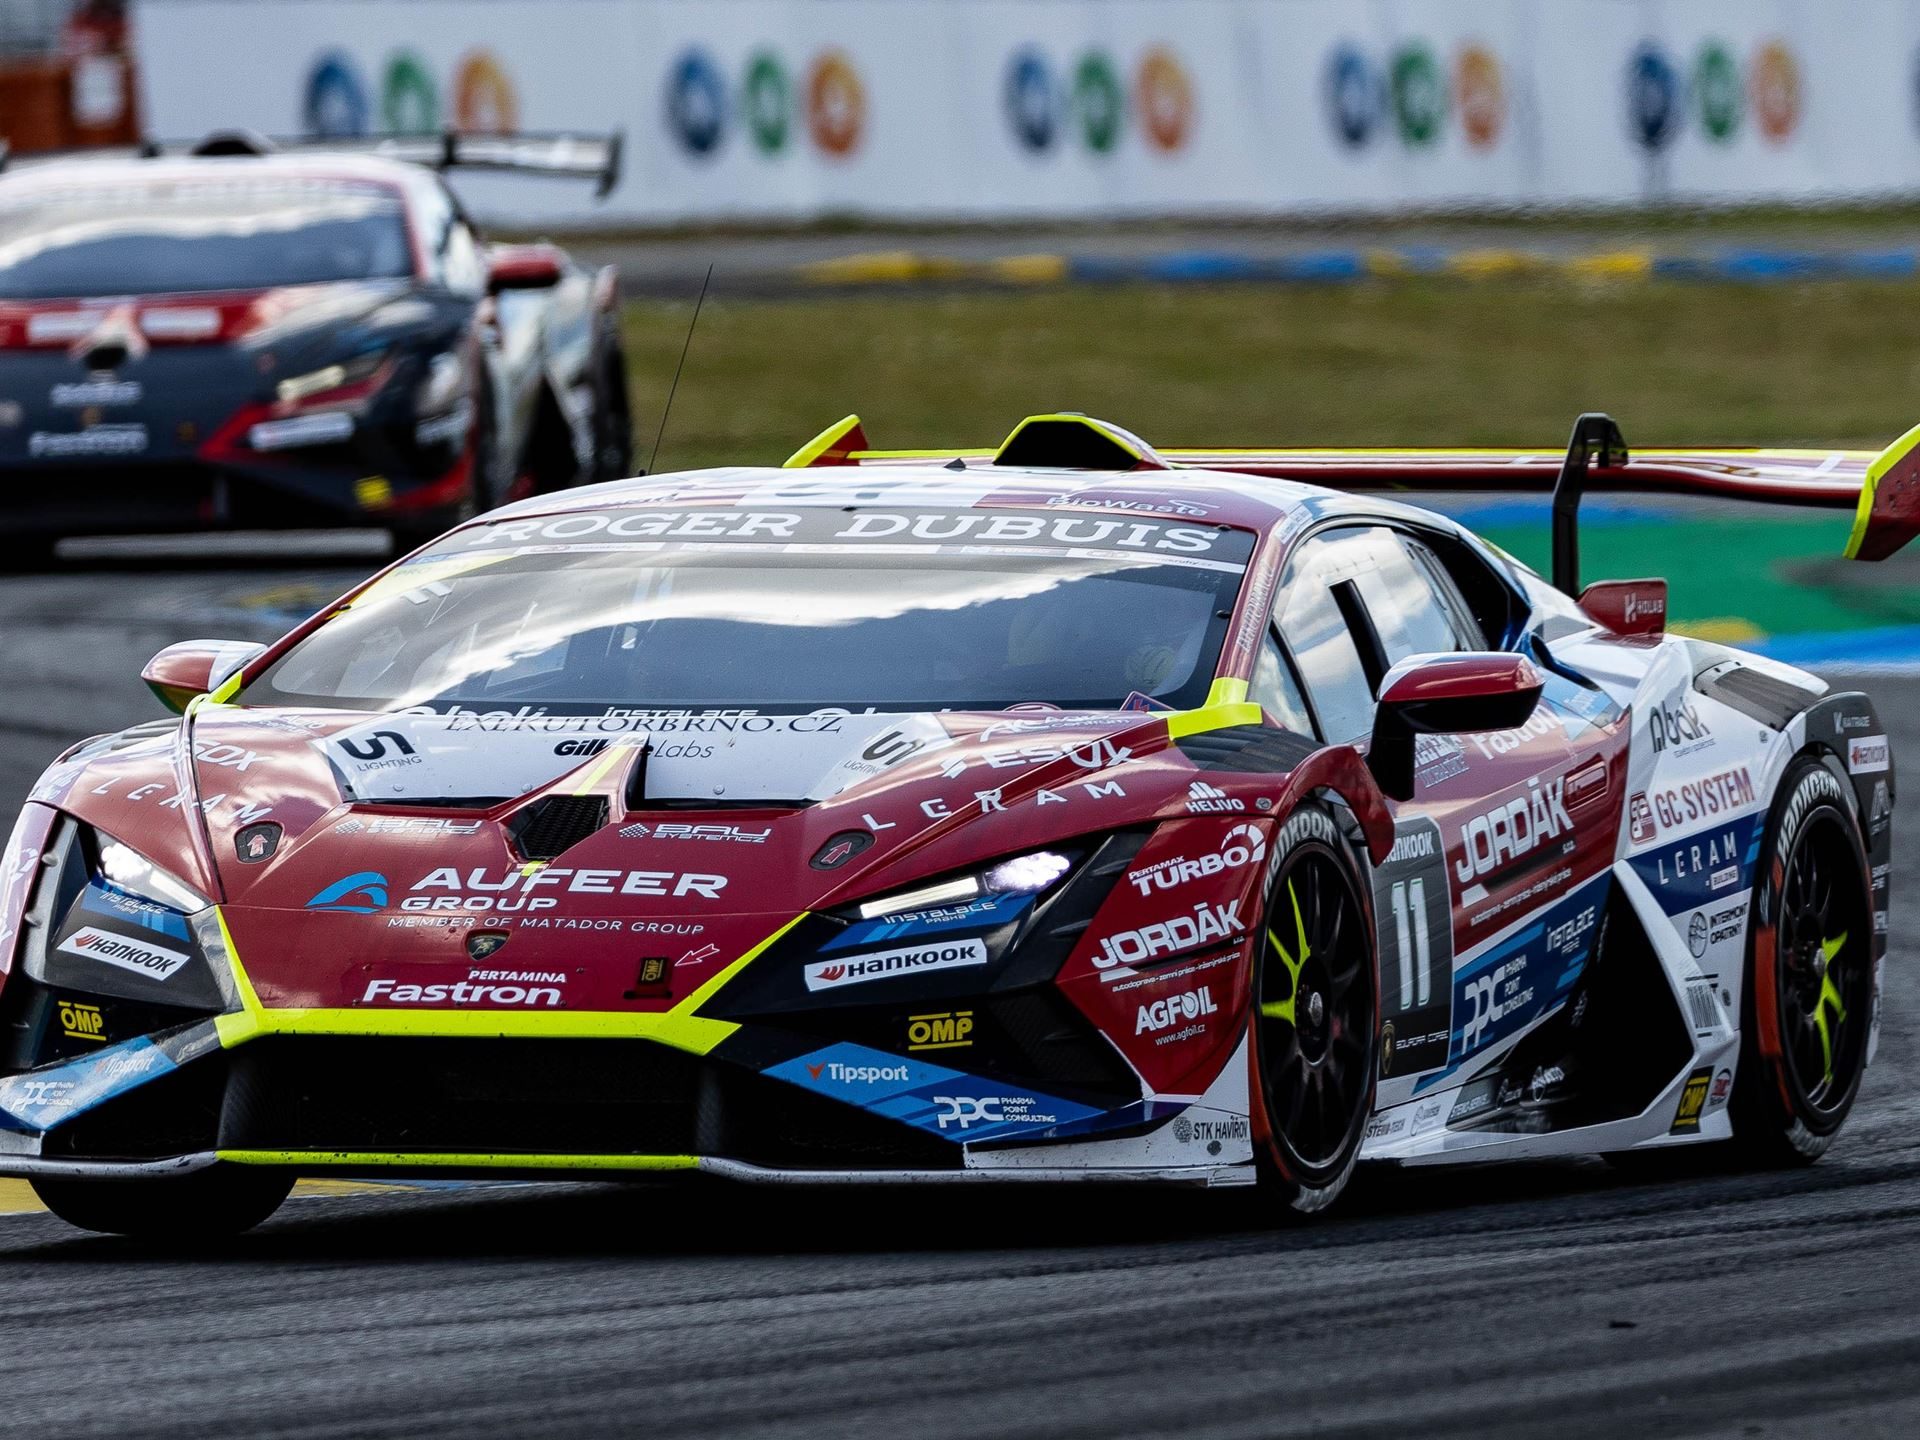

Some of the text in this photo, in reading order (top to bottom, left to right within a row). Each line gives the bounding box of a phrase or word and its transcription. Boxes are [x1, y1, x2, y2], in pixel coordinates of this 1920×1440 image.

[469, 512, 1221, 553] ROGER DUBUIS
[653, 740, 714, 758] Labs
[355, 754, 423, 773] LIGHTING
[862, 780, 1126, 831] LERAM
[1184, 798, 1246, 814] HELIVO
[1654, 790, 1684, 829] GC
[1680, 766, 1757, 822] SYSTEM
[655, 823, 773, 837] BAU
[1128, 855, 1185, 880] PERTAMAX
[1657, 830, 1738, 886] LERAM
[1131, 845, 1252, 897] TURBO
[409, 866, 729, 899] AUFEER
[399, 895, 558, 912] GROUP
[387, 916, 705, 935] MEMBER OF MATADOR GROUP
[1391, 877, 1432, 1011] 11
[468, 969, 567, 983] PERTAMINA
[361, 979, 562, 1006] Fastron
[60, 1008, 104, 1034] OMP
[1135, 985, 1219, 1036] AGFOIL
[908, 1017, 974, 1044] OMP
[1154, 1024, 1207, 1046] www.agfoil.cz
[828, 1063, 909, 1084] Tipsport
[1000, 1096, 1037, 1106] PHARMA
[1002, 1105, 1028, 1114] POINT
[1004, 1114, 1057, 1124] CONSULTING
[1193, 1121, 1213, 1141] STK
